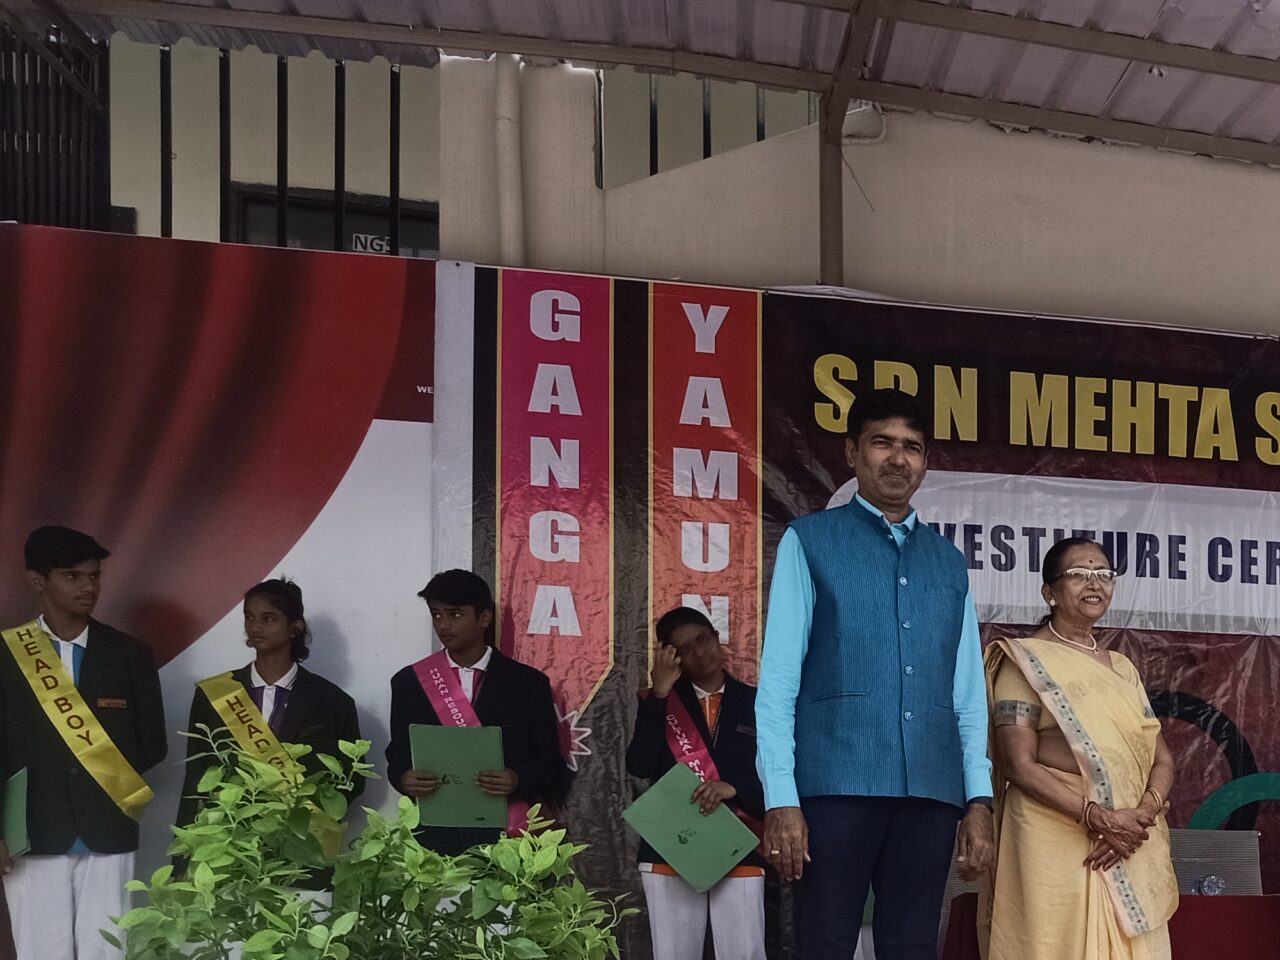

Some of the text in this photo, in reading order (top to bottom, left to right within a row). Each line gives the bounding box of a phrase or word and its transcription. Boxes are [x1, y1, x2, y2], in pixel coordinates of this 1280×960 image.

[527, 289, 582, 637] GANGA
[1009, 370, 1239, 462] MEHTA
[16, 628, 94, 746] HEAD BOY
[666, 714, 695, 756] CULTURAL
